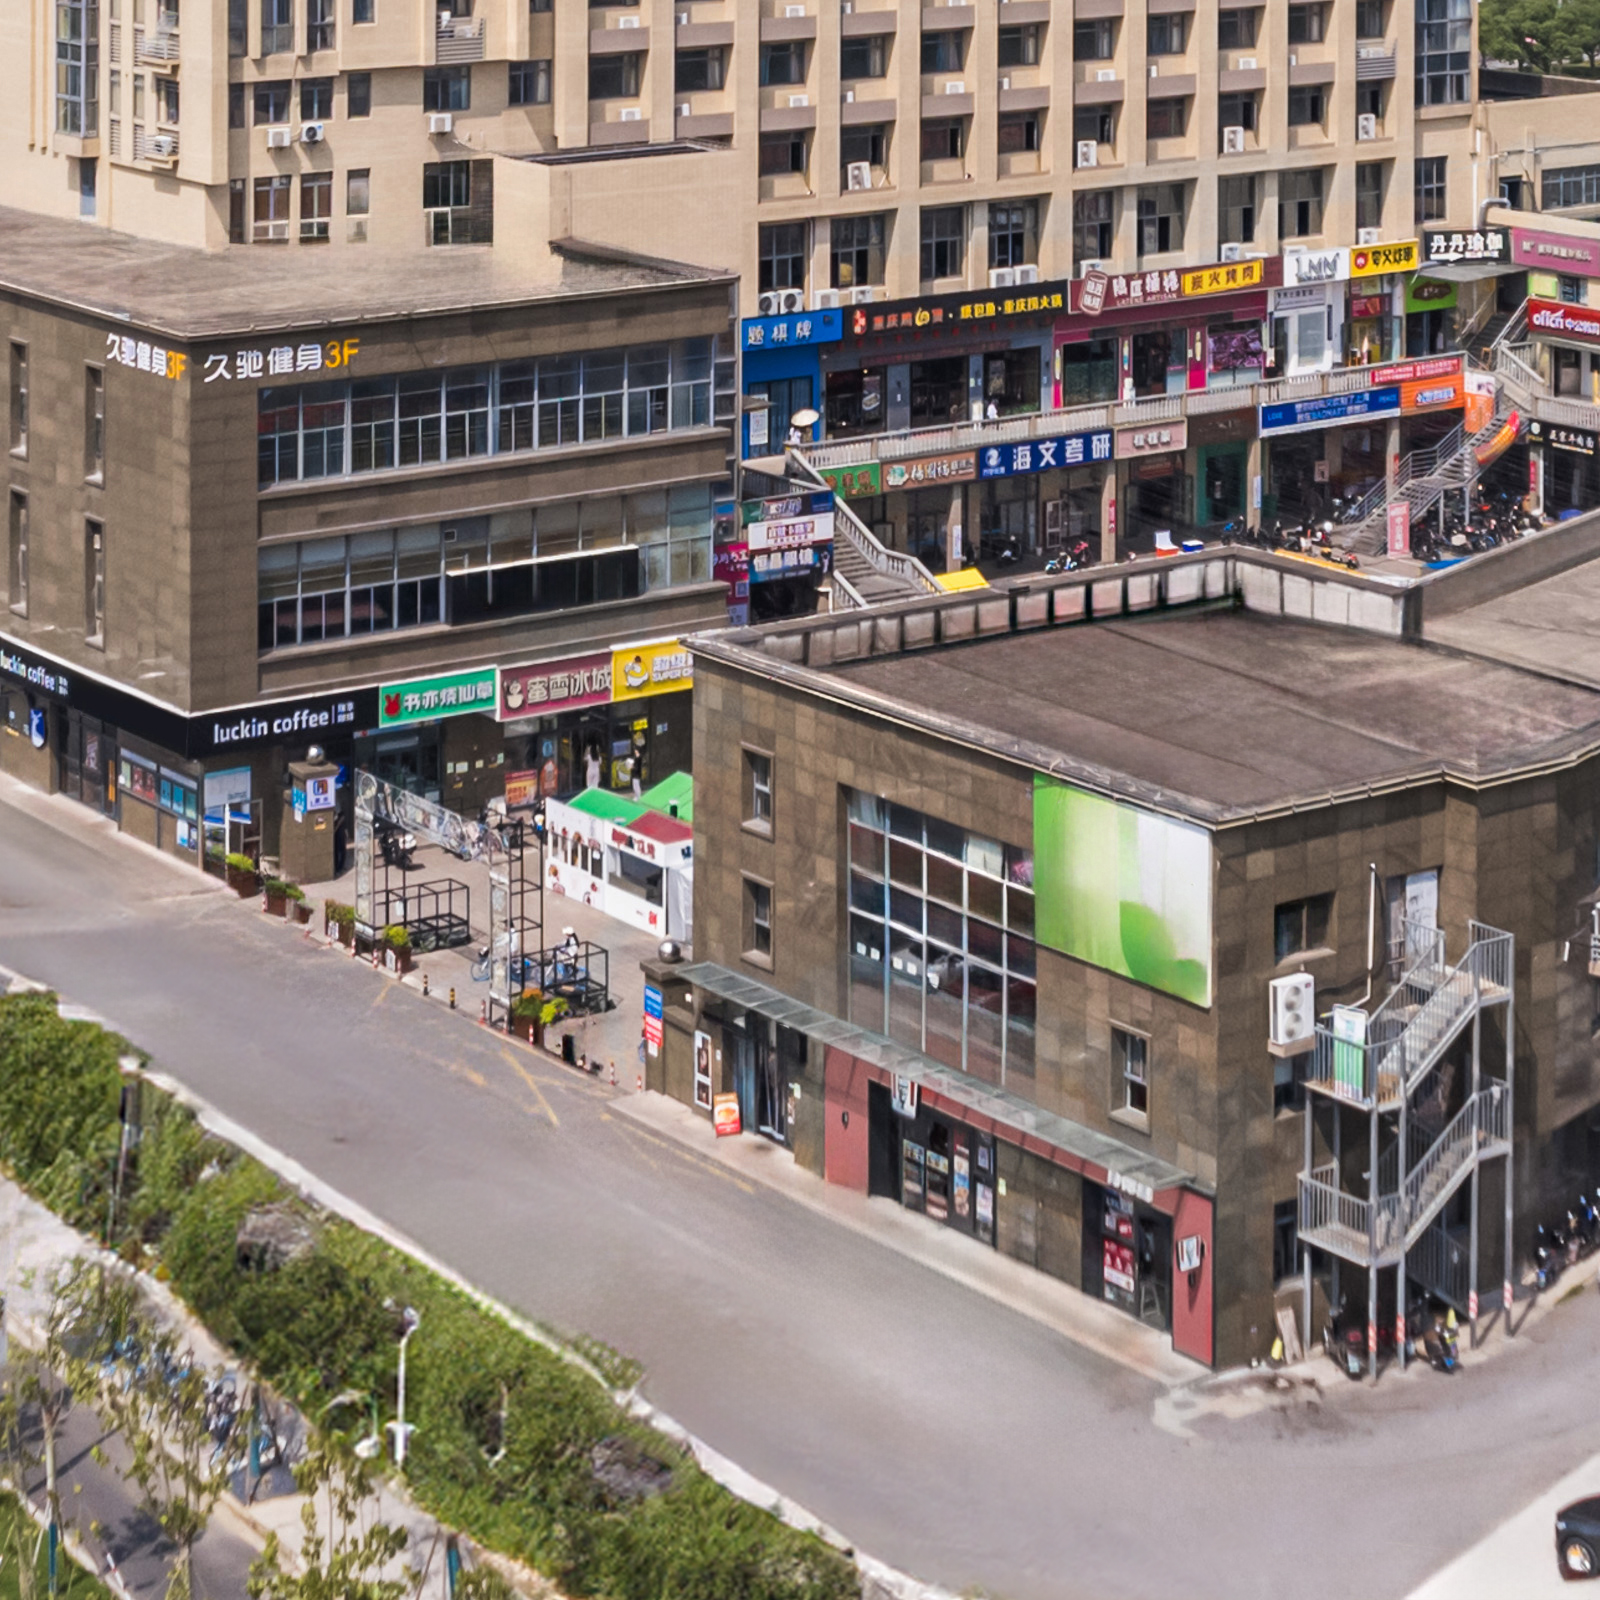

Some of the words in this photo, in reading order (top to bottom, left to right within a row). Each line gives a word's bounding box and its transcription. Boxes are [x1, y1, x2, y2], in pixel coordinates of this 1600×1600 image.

[1430, 231, 1504, 253] 丹丹瑜伽
[1190, 265, 1255, 292] 炭火烤肉
[1532, 309, 1565, 329] offcn
[105, 332, 188, 380] 久驰健身3F
[203, 338, 360, 383] 久驰健身3F
[1012, 433, 1111, 472] 海文考研
[0, 648, 27, 679] luckin
[27, 666, 56, 692] coffee
[526, 666, 613, 705] 蜜雪冰城
[402, 680, 494, 712] 书亦烧仙草
[213, 717, 269, 745] luckin
[272, 709, 330, 735] coffee
